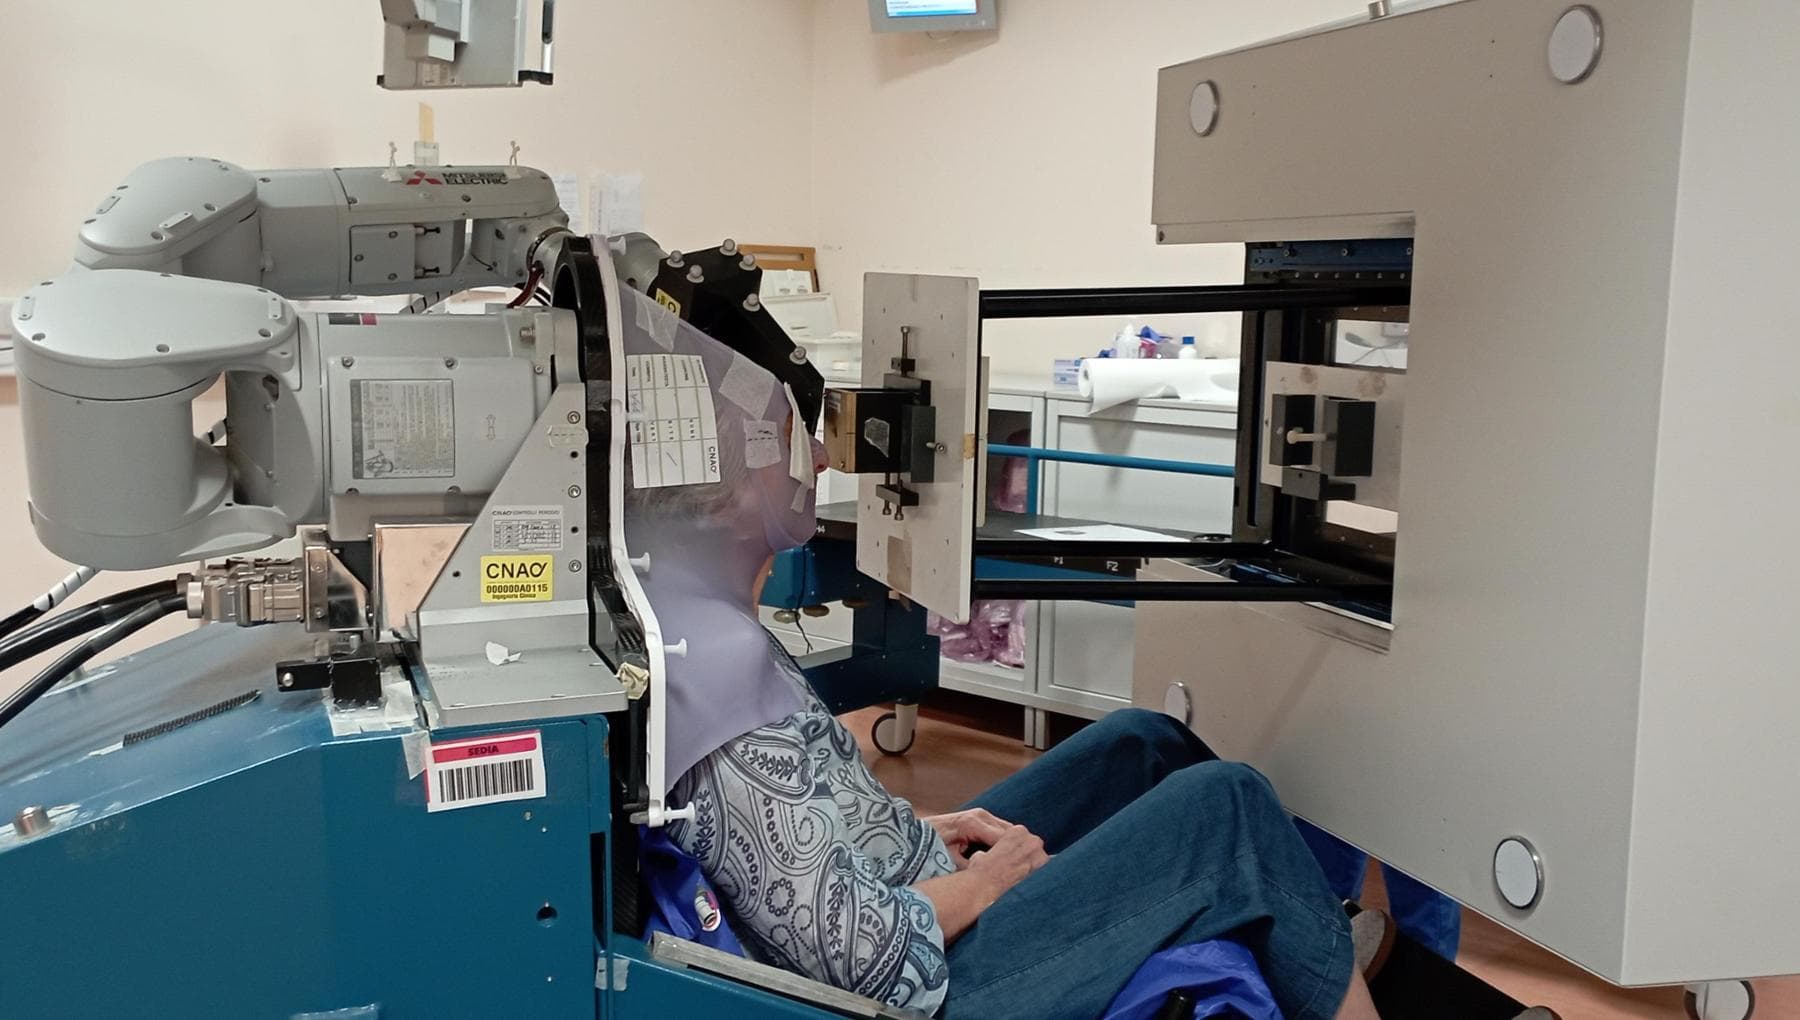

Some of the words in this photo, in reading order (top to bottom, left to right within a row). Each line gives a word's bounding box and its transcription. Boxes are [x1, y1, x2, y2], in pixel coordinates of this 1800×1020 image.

[708, 446, 718, 474] CNAO
[486, 562, 548, 579] CNAO
[1106, 560, 1119, 572] F2
[467, 745, 499, 756] SEDIA
